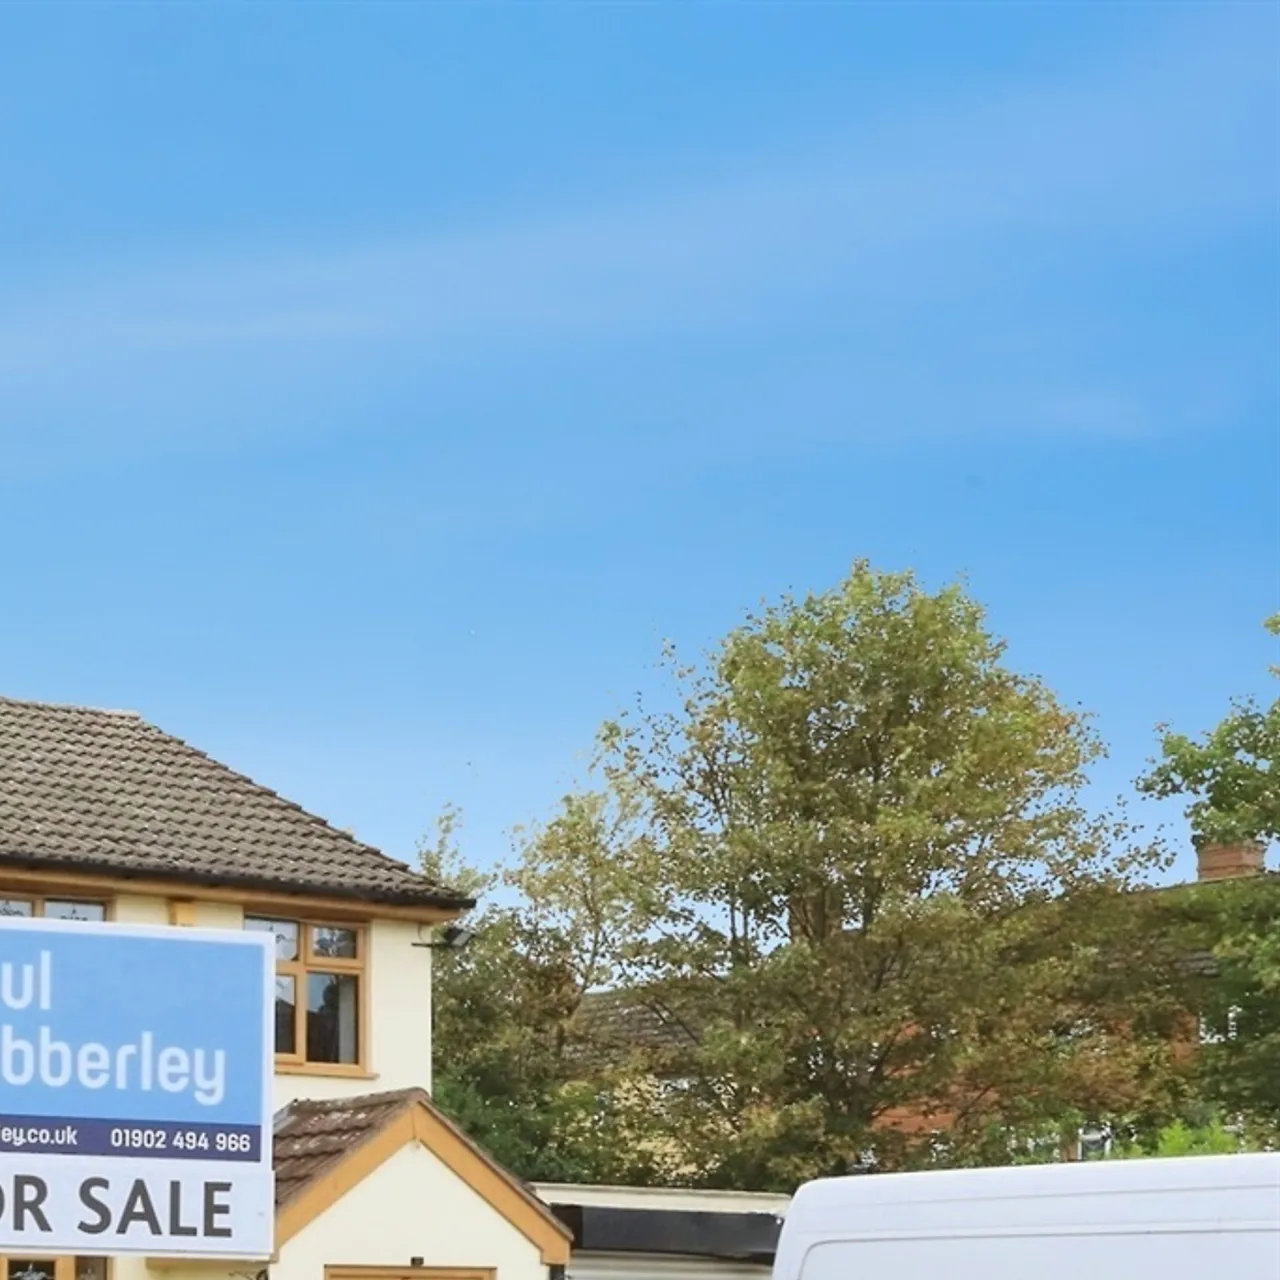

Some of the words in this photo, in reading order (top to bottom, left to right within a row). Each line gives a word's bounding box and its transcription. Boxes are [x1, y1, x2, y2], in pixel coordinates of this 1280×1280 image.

[110, 1128, 167, 1149] 01902
[172, 1130, 209, 1151] 494
[215, 1132, 251, 1153] 966
[76, 1176, 233, 1239] SALE
